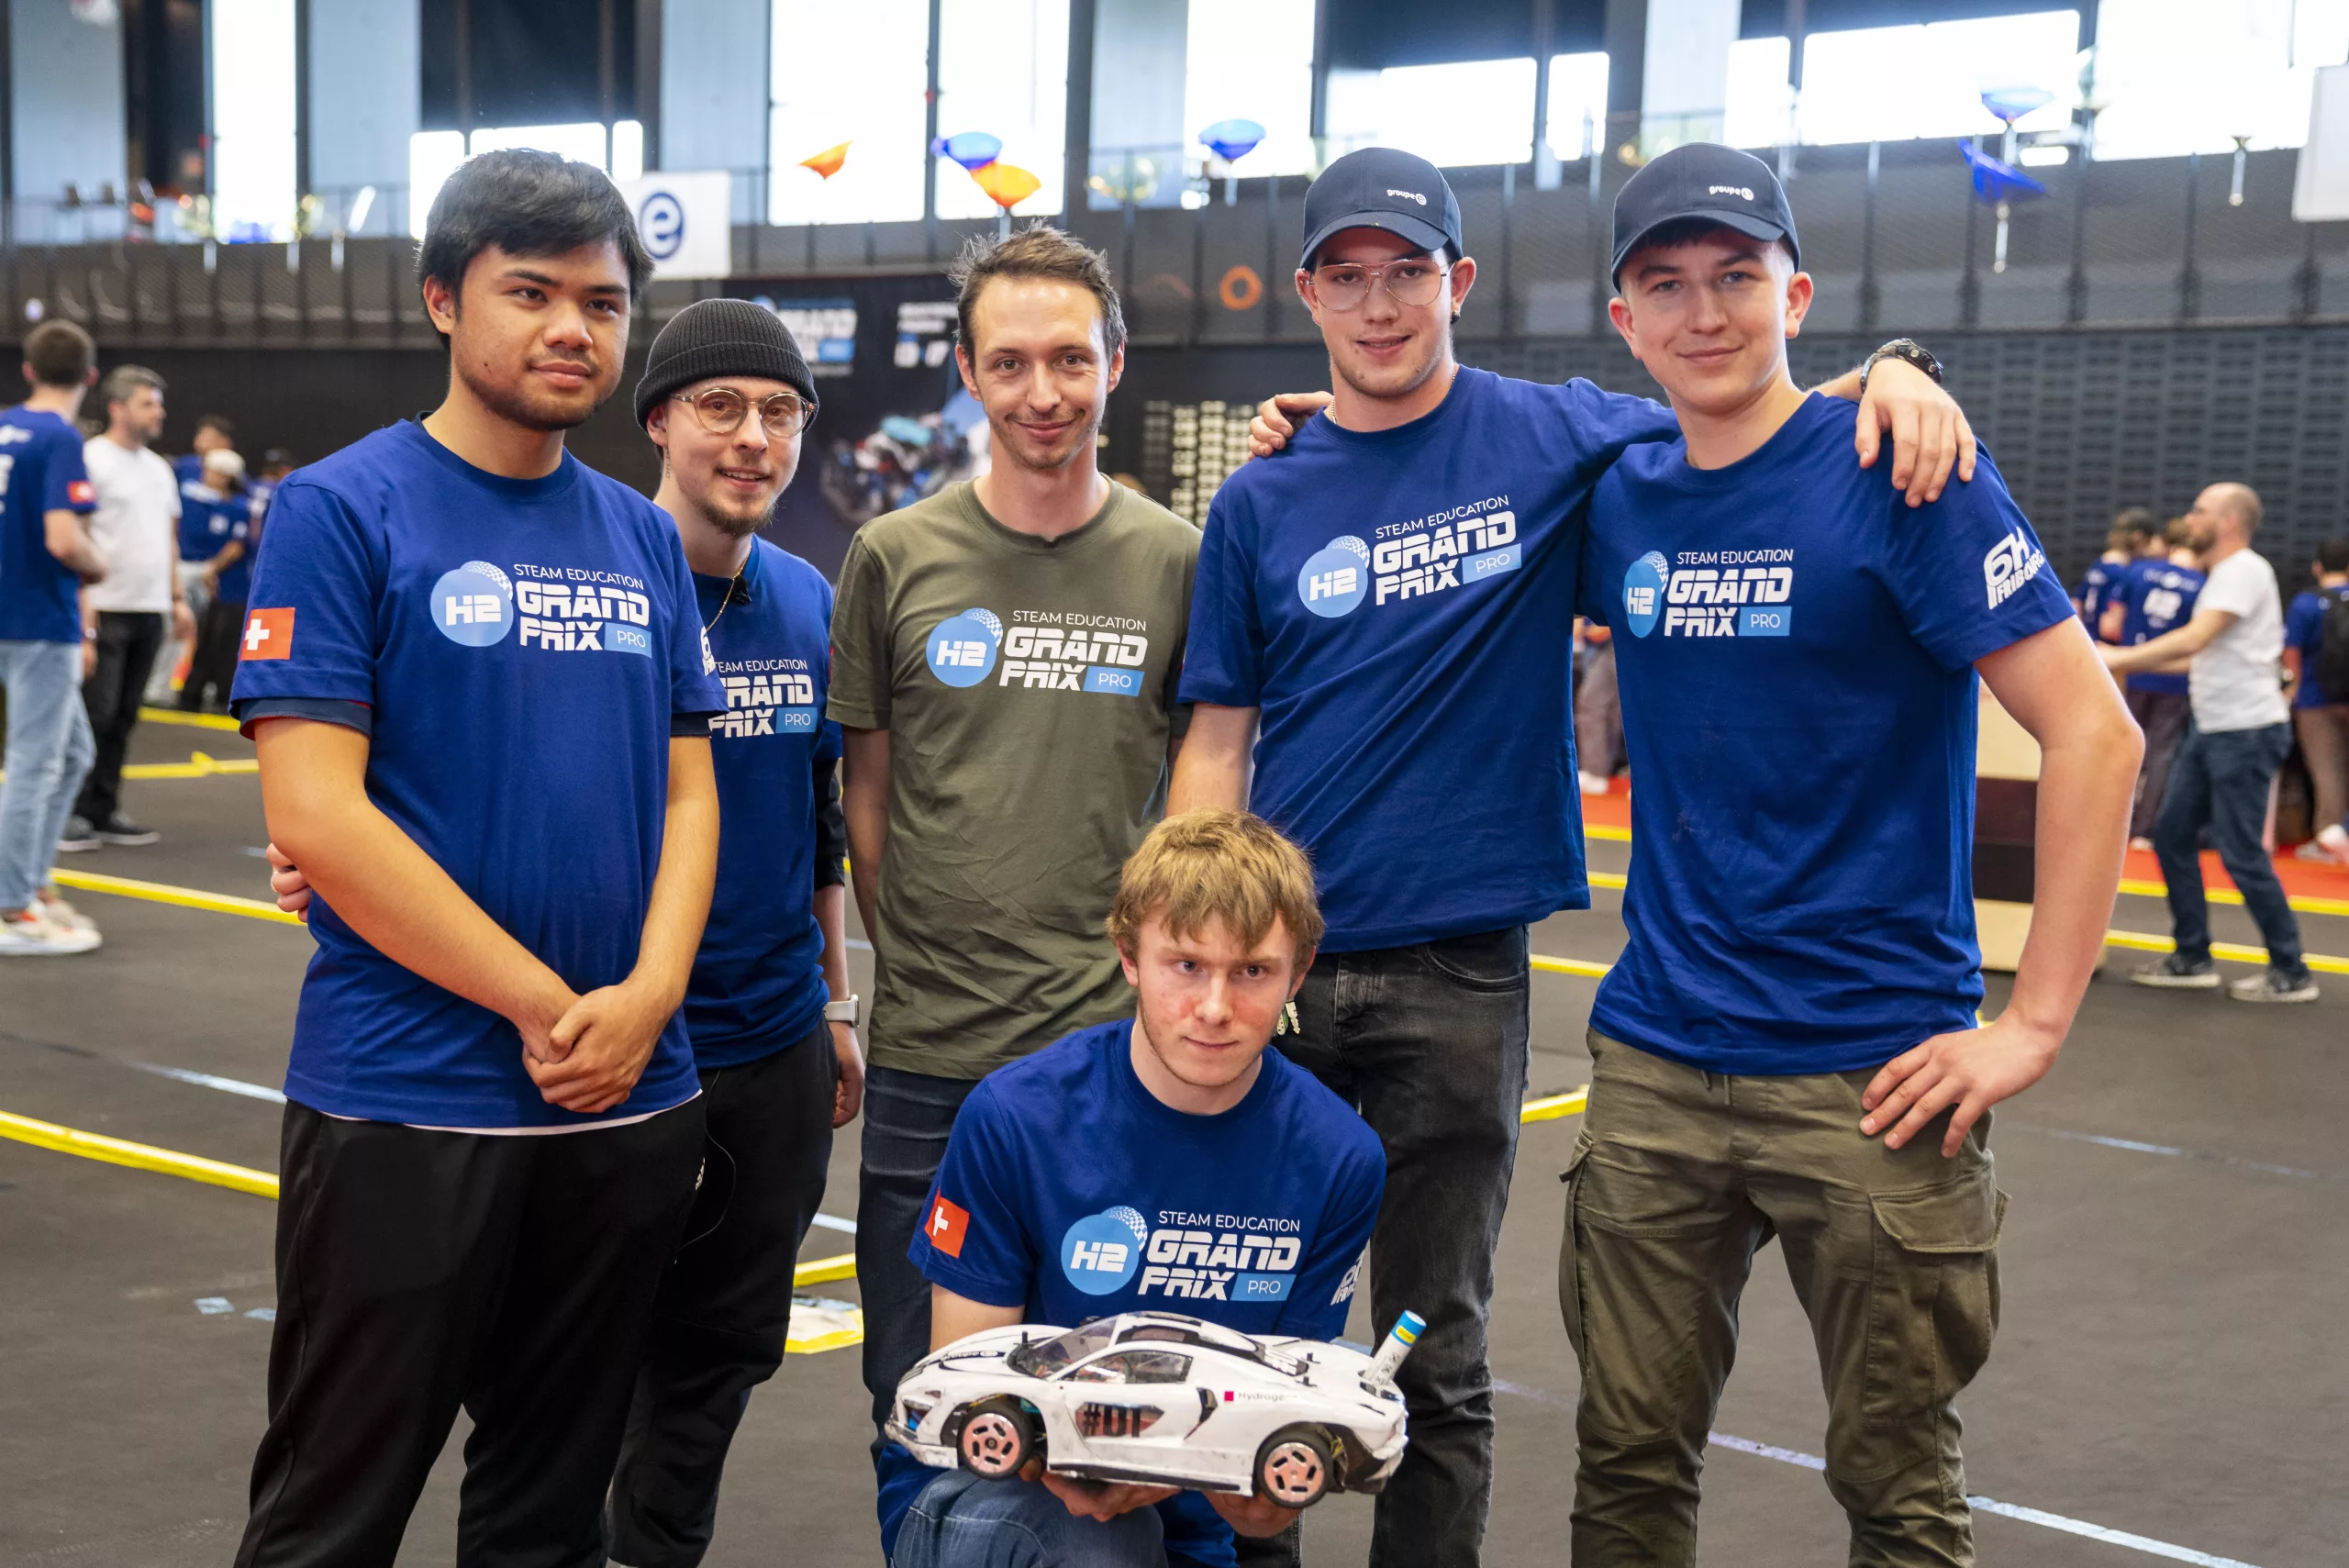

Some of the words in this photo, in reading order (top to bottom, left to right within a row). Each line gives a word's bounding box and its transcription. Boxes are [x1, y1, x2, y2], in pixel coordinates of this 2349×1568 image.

[1386, 189, 1416, 199] groupe
[640, 193, 683, 259] e
[1375, 518, 1424, 539] STEAM
[1428, 495, 1509, 526] EDUCATION
[1373, 510, 1516, 574] GRAND
[1676, 551, 1718, 565] STEAM
[1720, 549, 1794, 564] EDUCATION
[514, 563, 562, 580] STEAM
[567, 568, 644, 590] EDUCATION
[1309, 567, 1357, 601] H2
[1375, 558, 1461, 606] PRIX
[1475, 553, 1510, 573] PRO
[1667, 567, 1793, 604] GRAND
[445, 595, 501, 626] H2
[516, 580, 650, 627] GRAND
[1627, 587, 1655, 616] H2
[519, 616, 603, 651] PRIX
[617, 630, 646, 648] PRO
[1013, 610, 1062, 624] STEAM
[1066, 614, 1146, 631] EDUCATION
[1664, 606, 1738, 637] PRIX
[1751, 614, 1781, 628] PRO
[936, 640, 986, 667] H2
[1004, 627, 1148, 666] GRAND
[714, 661, 743, 673] EAM
[745, 659, 807, 672] EDUCATION
[999, 660, 1087, 692] PRIX
[1098, 673, 1132, 688] PRO
[719, 674, 814, 707] RAND
[785, 713, 811, 726] PRO
[1159, 1210, 1210, 1227] STEAM
[1216, 1215, 1300, 1232] EDUCATION
[1070, 1240, 1128, 1273] H2
[1147, 1229, 1301, 1271] GRAND
[1138, 1266, 1235, 1301] PRIX
[1248, 1280, 1281, 1295] PRO
